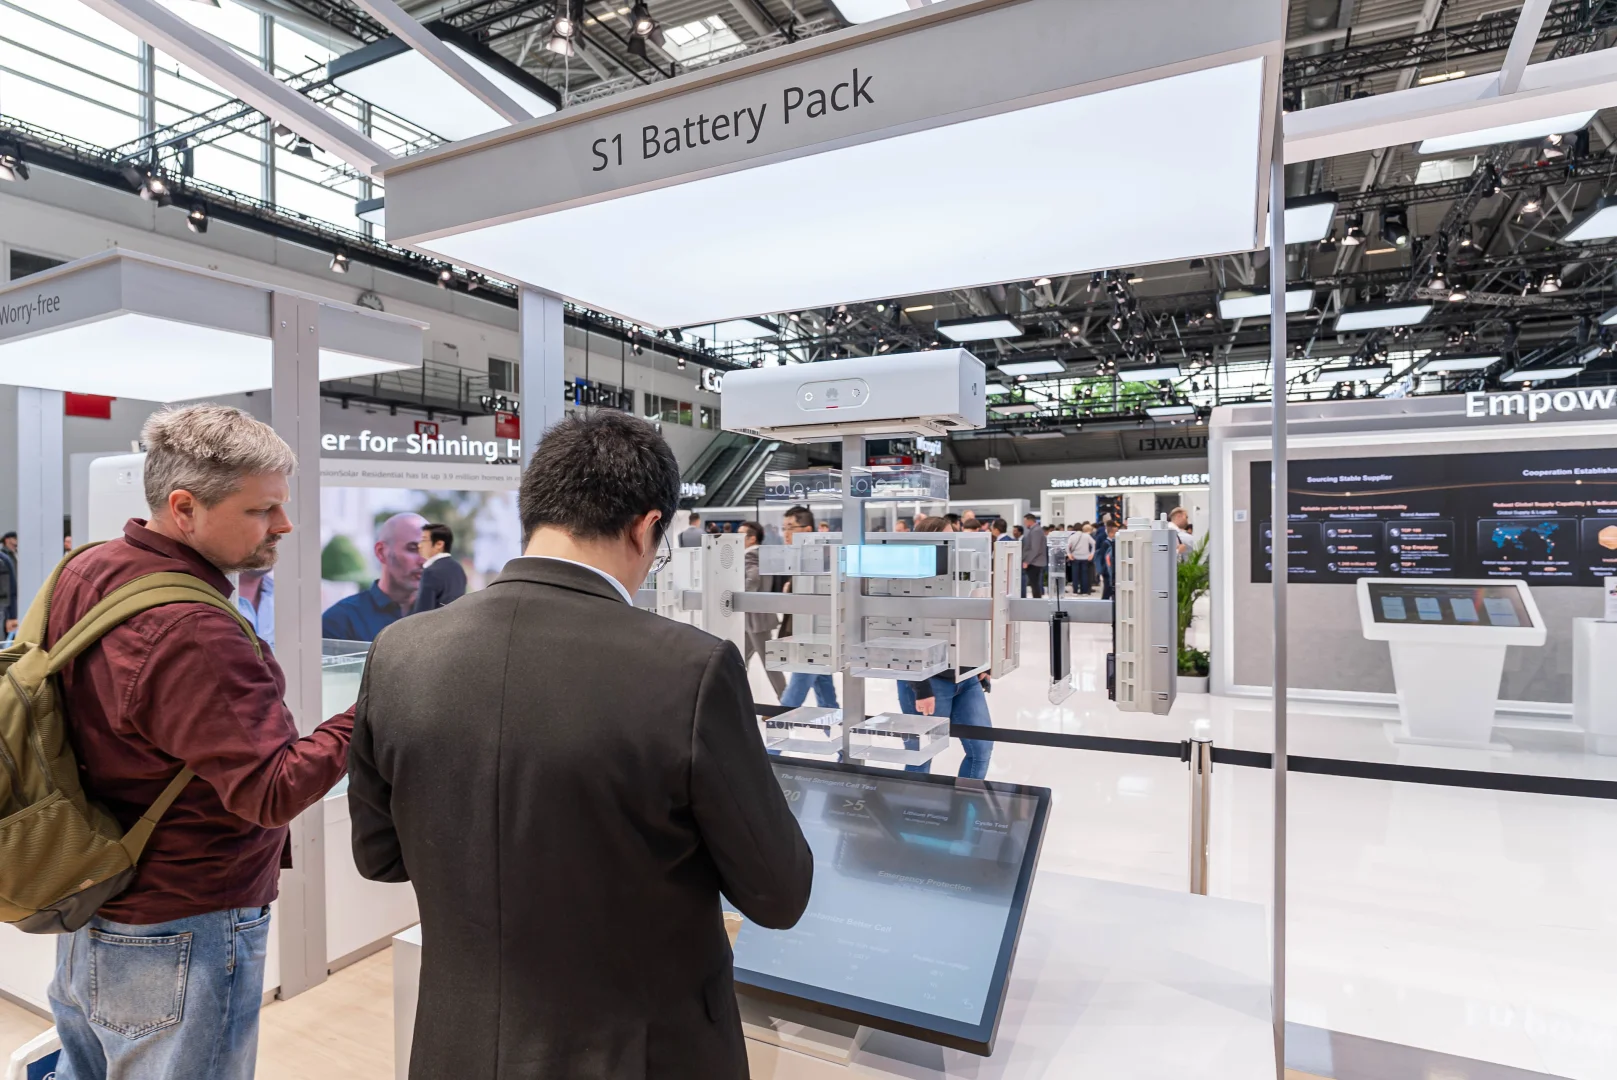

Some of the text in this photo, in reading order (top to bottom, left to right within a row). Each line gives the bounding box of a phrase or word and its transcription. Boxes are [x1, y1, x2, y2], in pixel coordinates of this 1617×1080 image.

[591, 67, 875, 172] S1 Battery Pack
[0, 293, 61, 326] Worry-free
[1465, 388, 1617, 422] Empow
[358, 429, 399, 453] for
[405, 434, 499, 462] Shining
[361, 470, 404, 479] Residential
[405, 472, 420, 480] has
[431, 474, 441, 482] up
[455, 473, 480, 481] million
[481, 474, 505, 482] homes
[1306, 476, 1339, 484] Sourcing
[1362, 474, 1394, 483] Supplier
[1522, 469, 1573, 477] Cooperation
[1050, 477, 1079, 489] Smart
[1079, 476, 1108, 489] String
[1108, 476, 1118, 487] &
[1118, 475, 1139, 486] Grid
[1140, 474, 1181, 487] Forming
[1181, 474, 1200, 484] ESS
[812, 777, 845, 787] Stringent
[842, 799, 866, 811] >5
[902, 809, 926, 818] Lithium
[974, 819, 993, 827] Cycle
[878, 870, 972, 892] Emergency Protection
